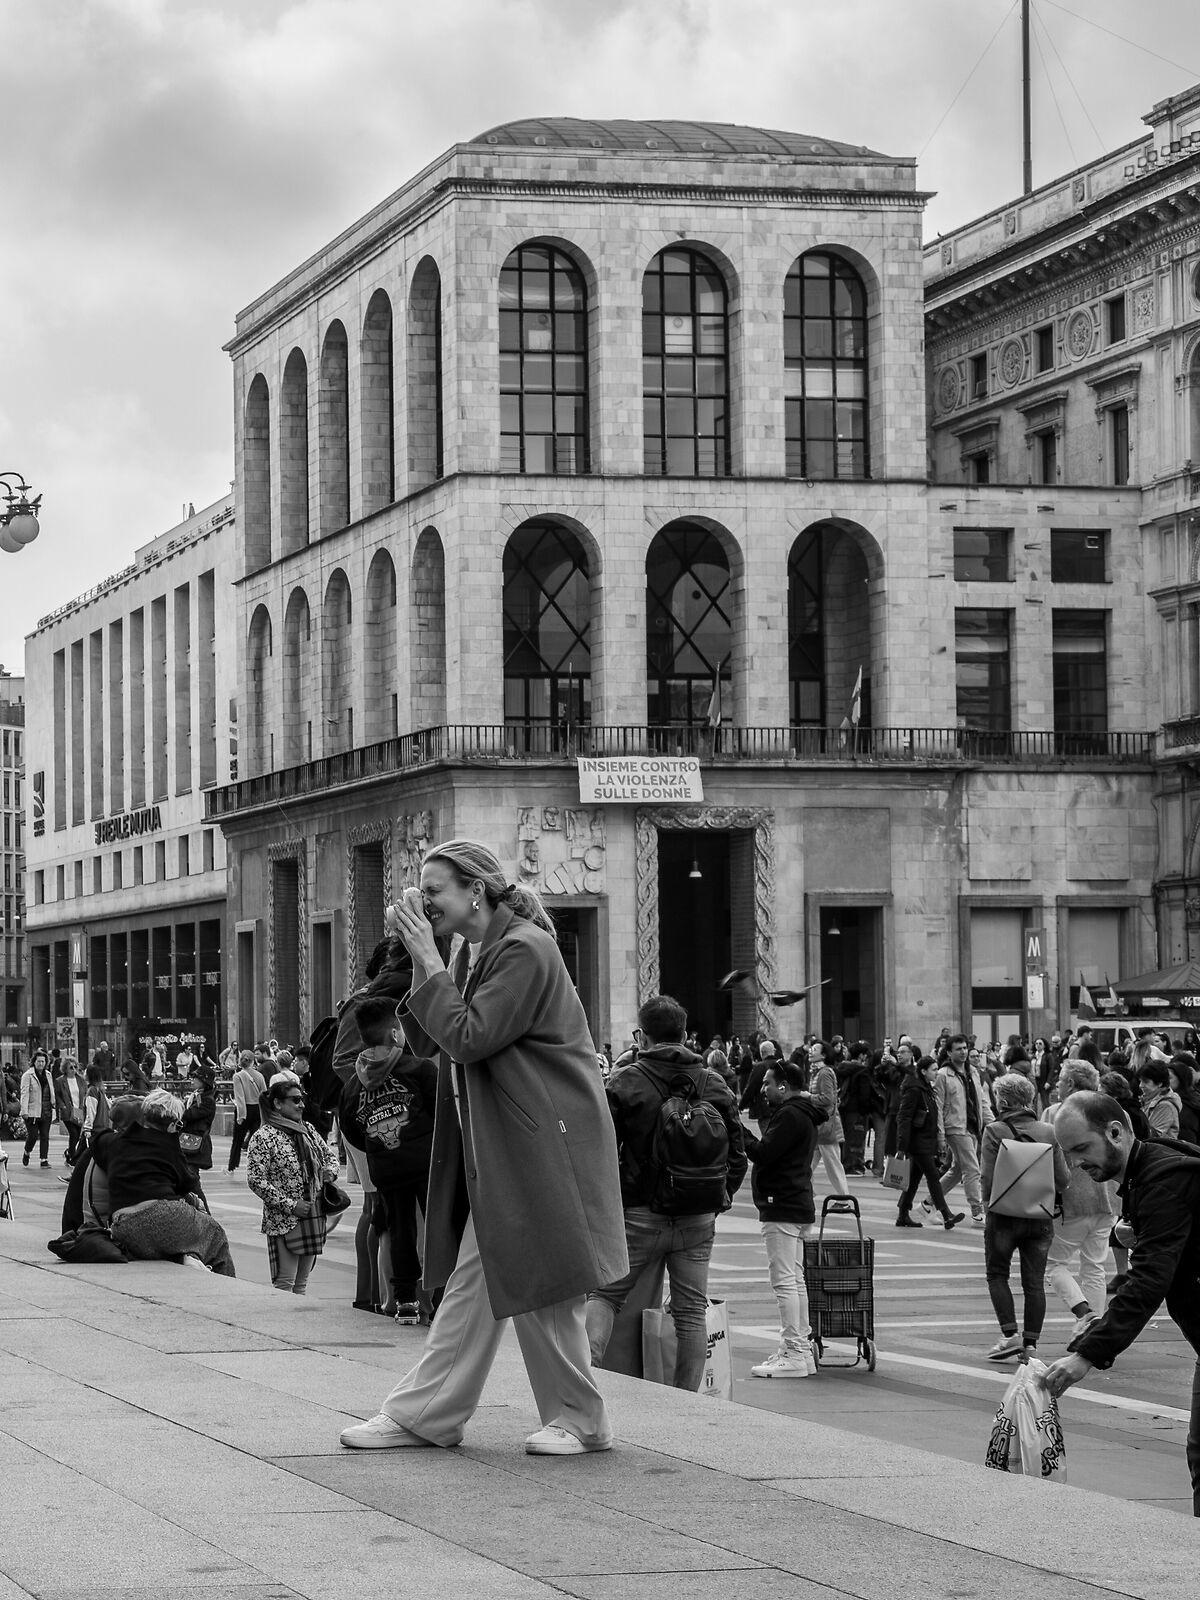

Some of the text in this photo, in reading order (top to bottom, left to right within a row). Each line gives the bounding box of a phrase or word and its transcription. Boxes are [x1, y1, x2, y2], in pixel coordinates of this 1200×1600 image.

[583, 761, 698, 773] INSIEME CONTRO
[598, 774, 687, 786] LA VIOLENZA
[594, 788, 692, 799] SULLE DONNE
[102, 805, 162, 843] REALE MUTUA
[72, 943, 82, 964] M
[1027, 936, 1041, 957] M
[356, 1078, 408, 1114] BULLS
[368, 1109, 392, 1125] CENTRAL
